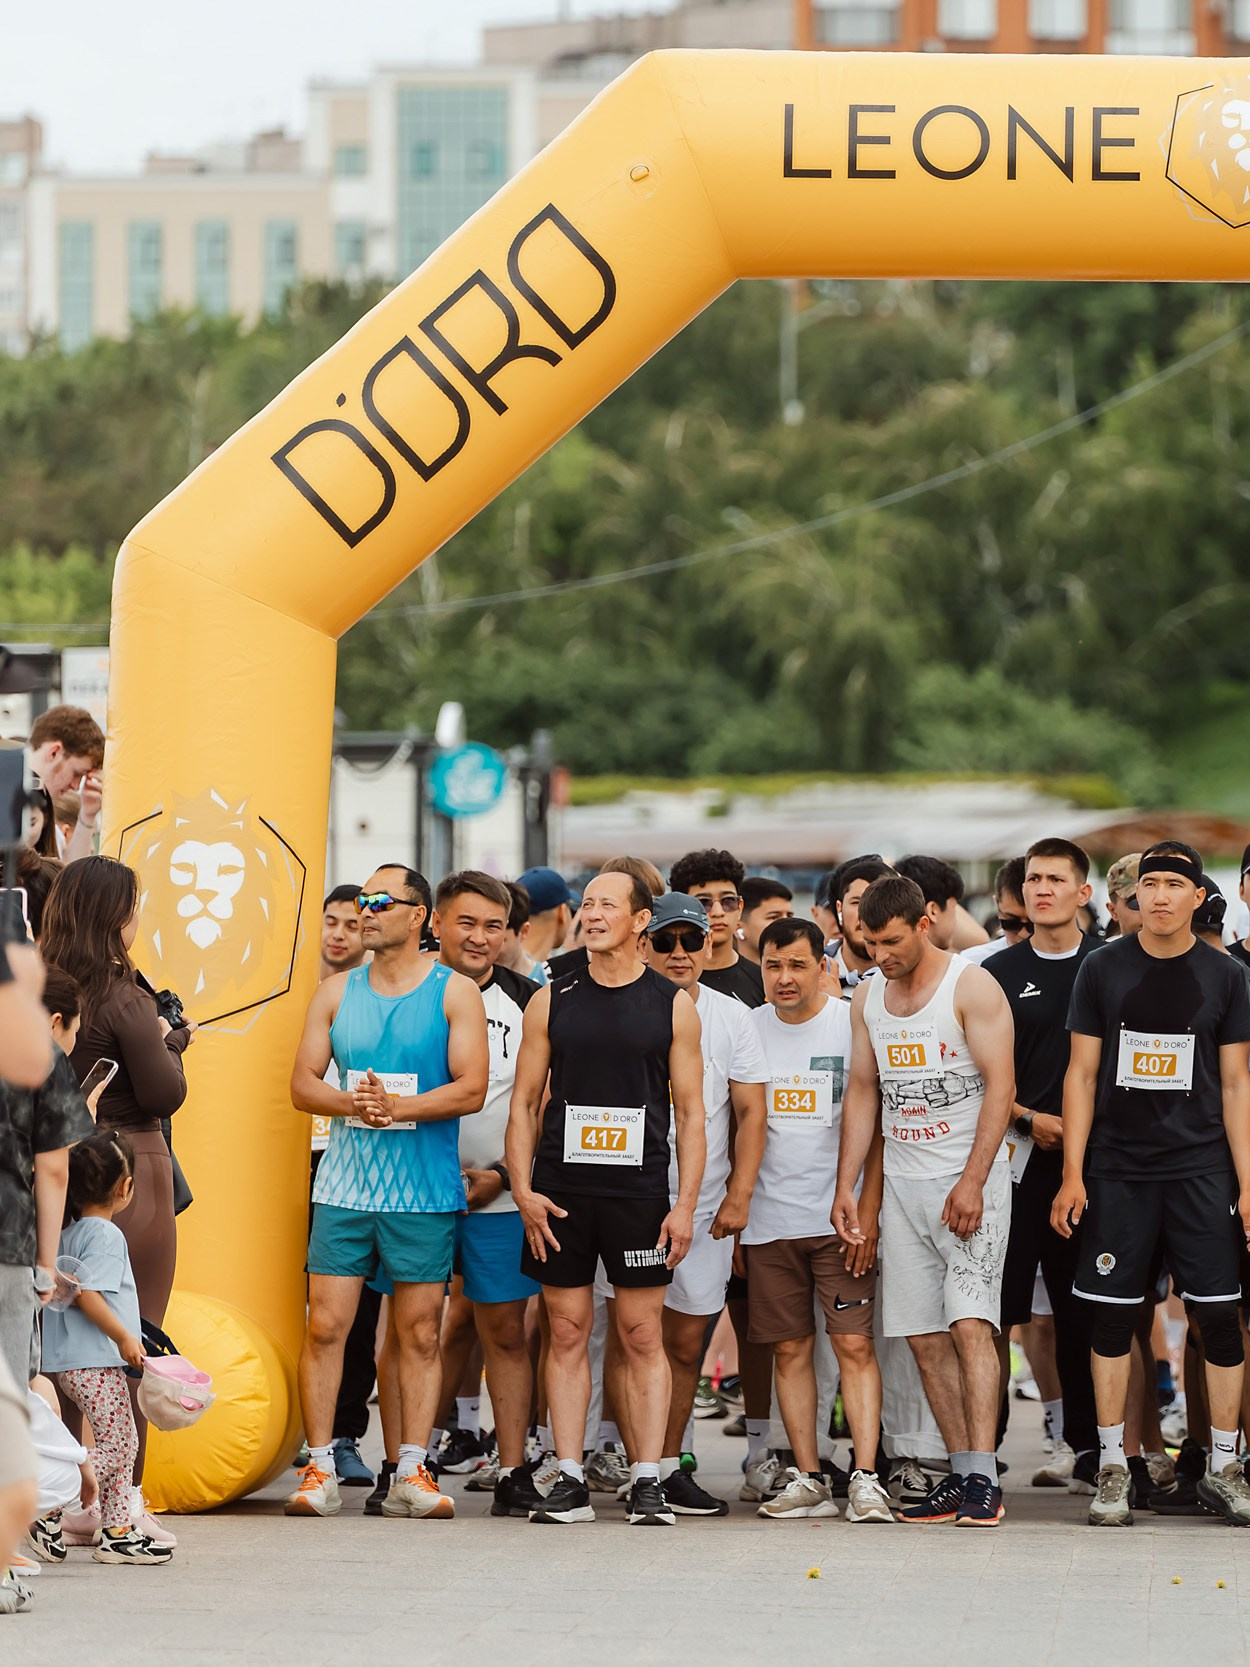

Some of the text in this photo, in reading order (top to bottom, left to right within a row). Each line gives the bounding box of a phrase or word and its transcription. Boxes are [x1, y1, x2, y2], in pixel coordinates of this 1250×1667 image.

[783, 103, 1141, 184] LEONE
[879, 1032, 899, 1040] LEONE
[1126, 1038, 1150, 1048] LEONE
[891, 1046, 921, 1065] 501
[1136, 1055, 1173, 1074] 407
[777, 1091, 813, 1110] 334
[572, 1113, 599, 1121] LEONE
[901, 1105, 927, 1117] AGAIN
[585, 1129, 623, 1148] 417
